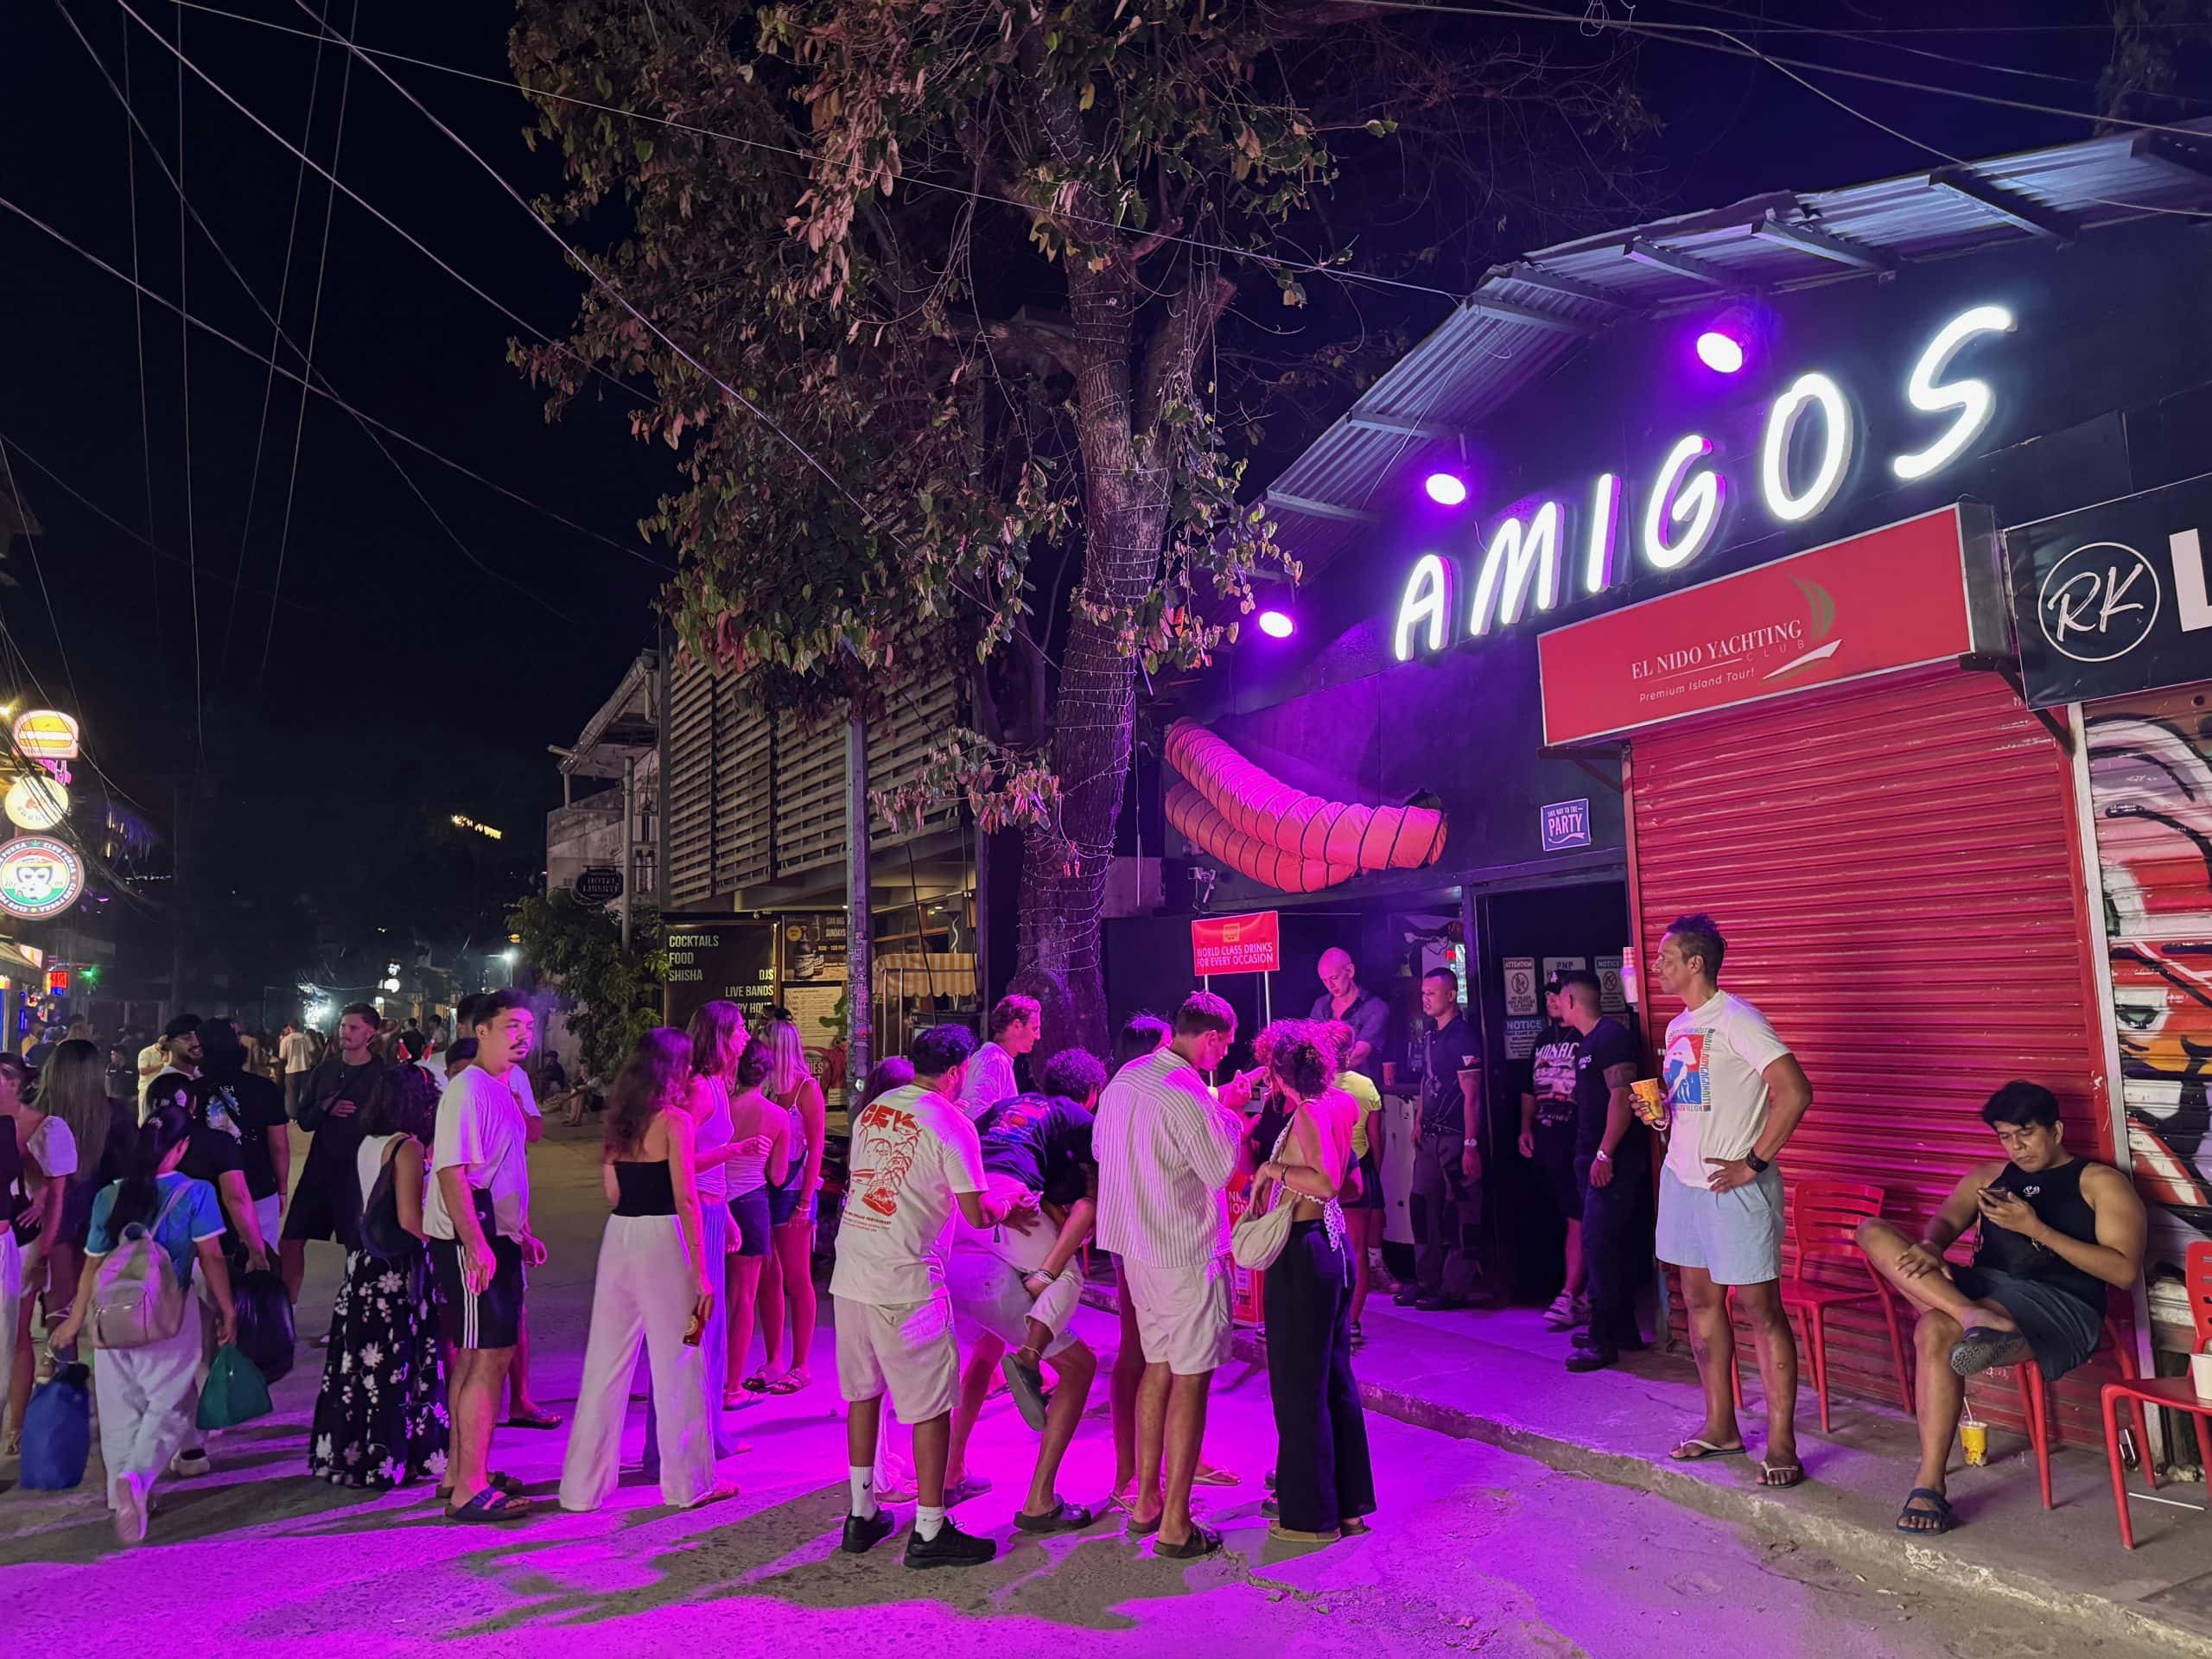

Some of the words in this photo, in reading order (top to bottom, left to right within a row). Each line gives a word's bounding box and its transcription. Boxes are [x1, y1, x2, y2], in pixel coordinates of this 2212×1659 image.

[1395, 306, 2015, 662] AMIGOS
[2047, 563, 2144, 642] RK
[1631, 662, 1652, 679] EL
[1656, 646, 1702, 674] NIDO
[1707, 620, 1802, 660] YACHTING
[1746, 639, 1804, 662] CLUB
[1639, 683, 1685, 702] Premium
[1689, 676, 1722, 691] Island
[1726, 667, 1755, 682] Tour!
[1548, 814, 1582, 836] PARTY
[669, 935, 719, 948] COCKTAILS
[1197, 947, 1219, 957] WORLD
[1221, 945, 1242, 955] CLASS
[1243, 942, 1273, 953] DRINKS
[669, 952, 694, 966] FOOD
[1197, 957, 1209, 968] FOR
[1211, 956, 1230, 966] EVERY
[1233, 953, 1273, 964] OCCASION
[669, 969, 702, 982] SHISHA
[759, 969, 774, 980] DJS
[725, 986, 743, 997] LIVE
[746, 985, 774, 996] BANDS
[1506, 1020, 1542, 1030] NOTICE
